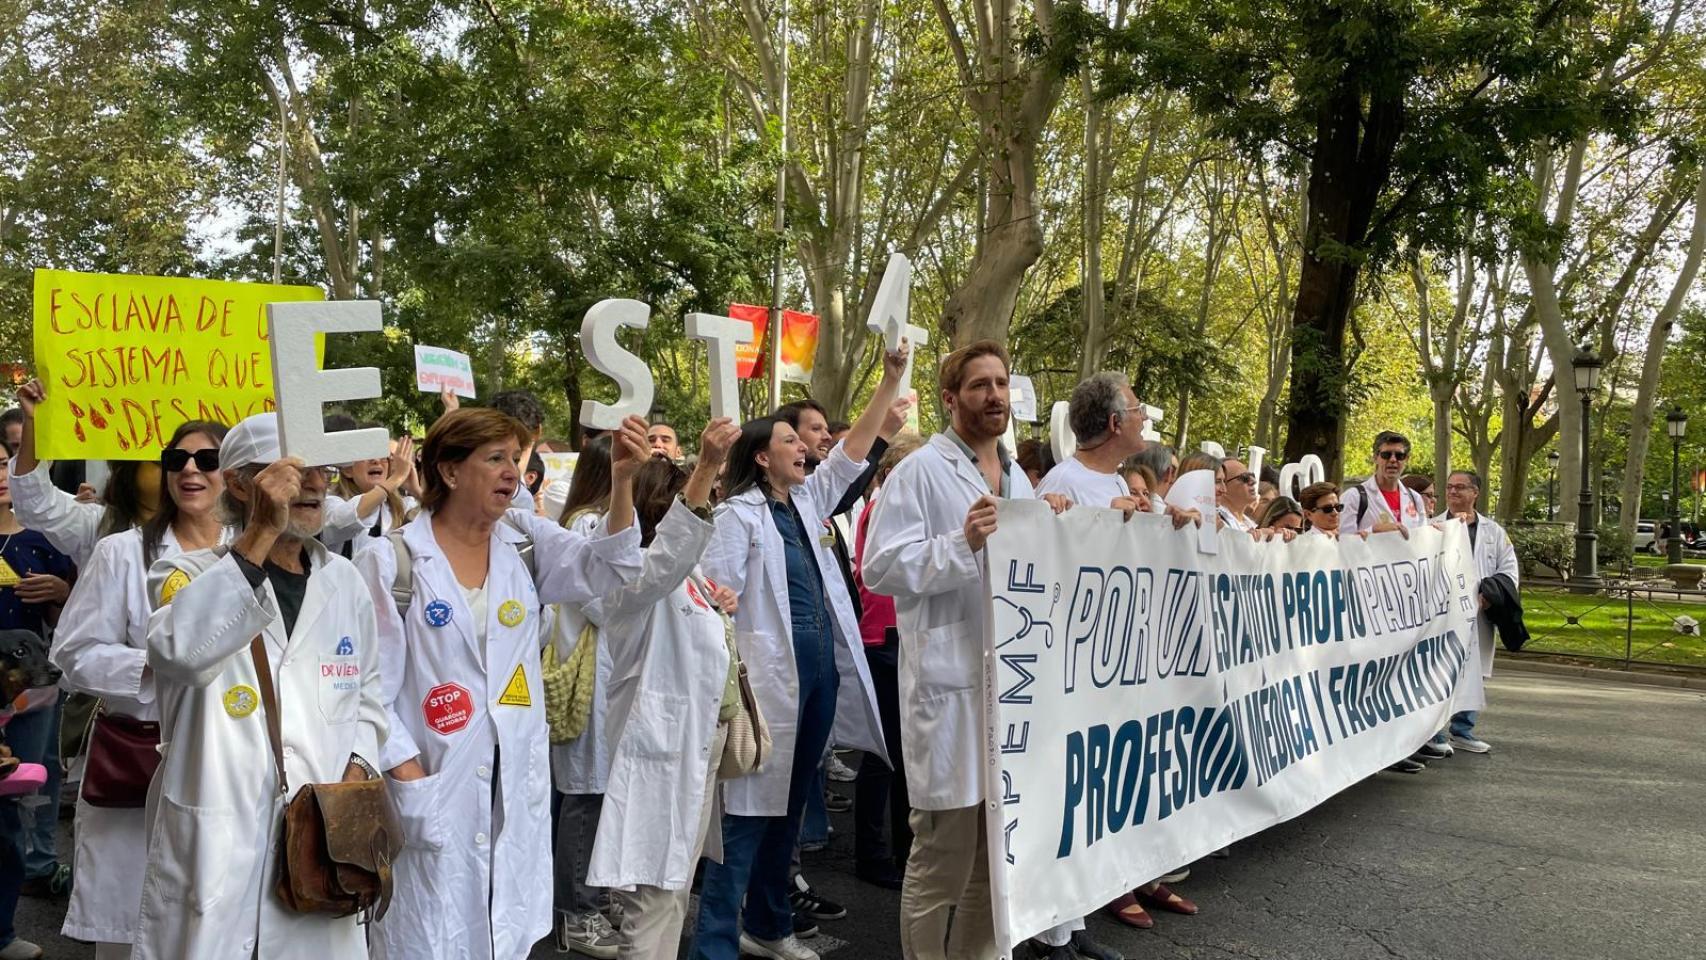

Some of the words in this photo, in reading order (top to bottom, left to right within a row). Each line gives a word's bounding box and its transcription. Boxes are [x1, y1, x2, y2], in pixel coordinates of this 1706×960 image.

[51, 288, 185, 335] ESCLAVA
[196, 295, 235, 337] DE
[61, 345, 191, 389] SISTEMA
[208, 347, 265, 389] QUE
[1065, 565, 1154, 694] POR
[1282, 569, 1367, 650] PROPIO
[1357, 558, 1431, 636] PARA
[430, 690, 461, 708] STOP
[1056, 678, 1250, 859] PROFESIÓN
[1245, 665, 1319, 788] MÉDICA
[1308, 670, 1333, 746] Y
